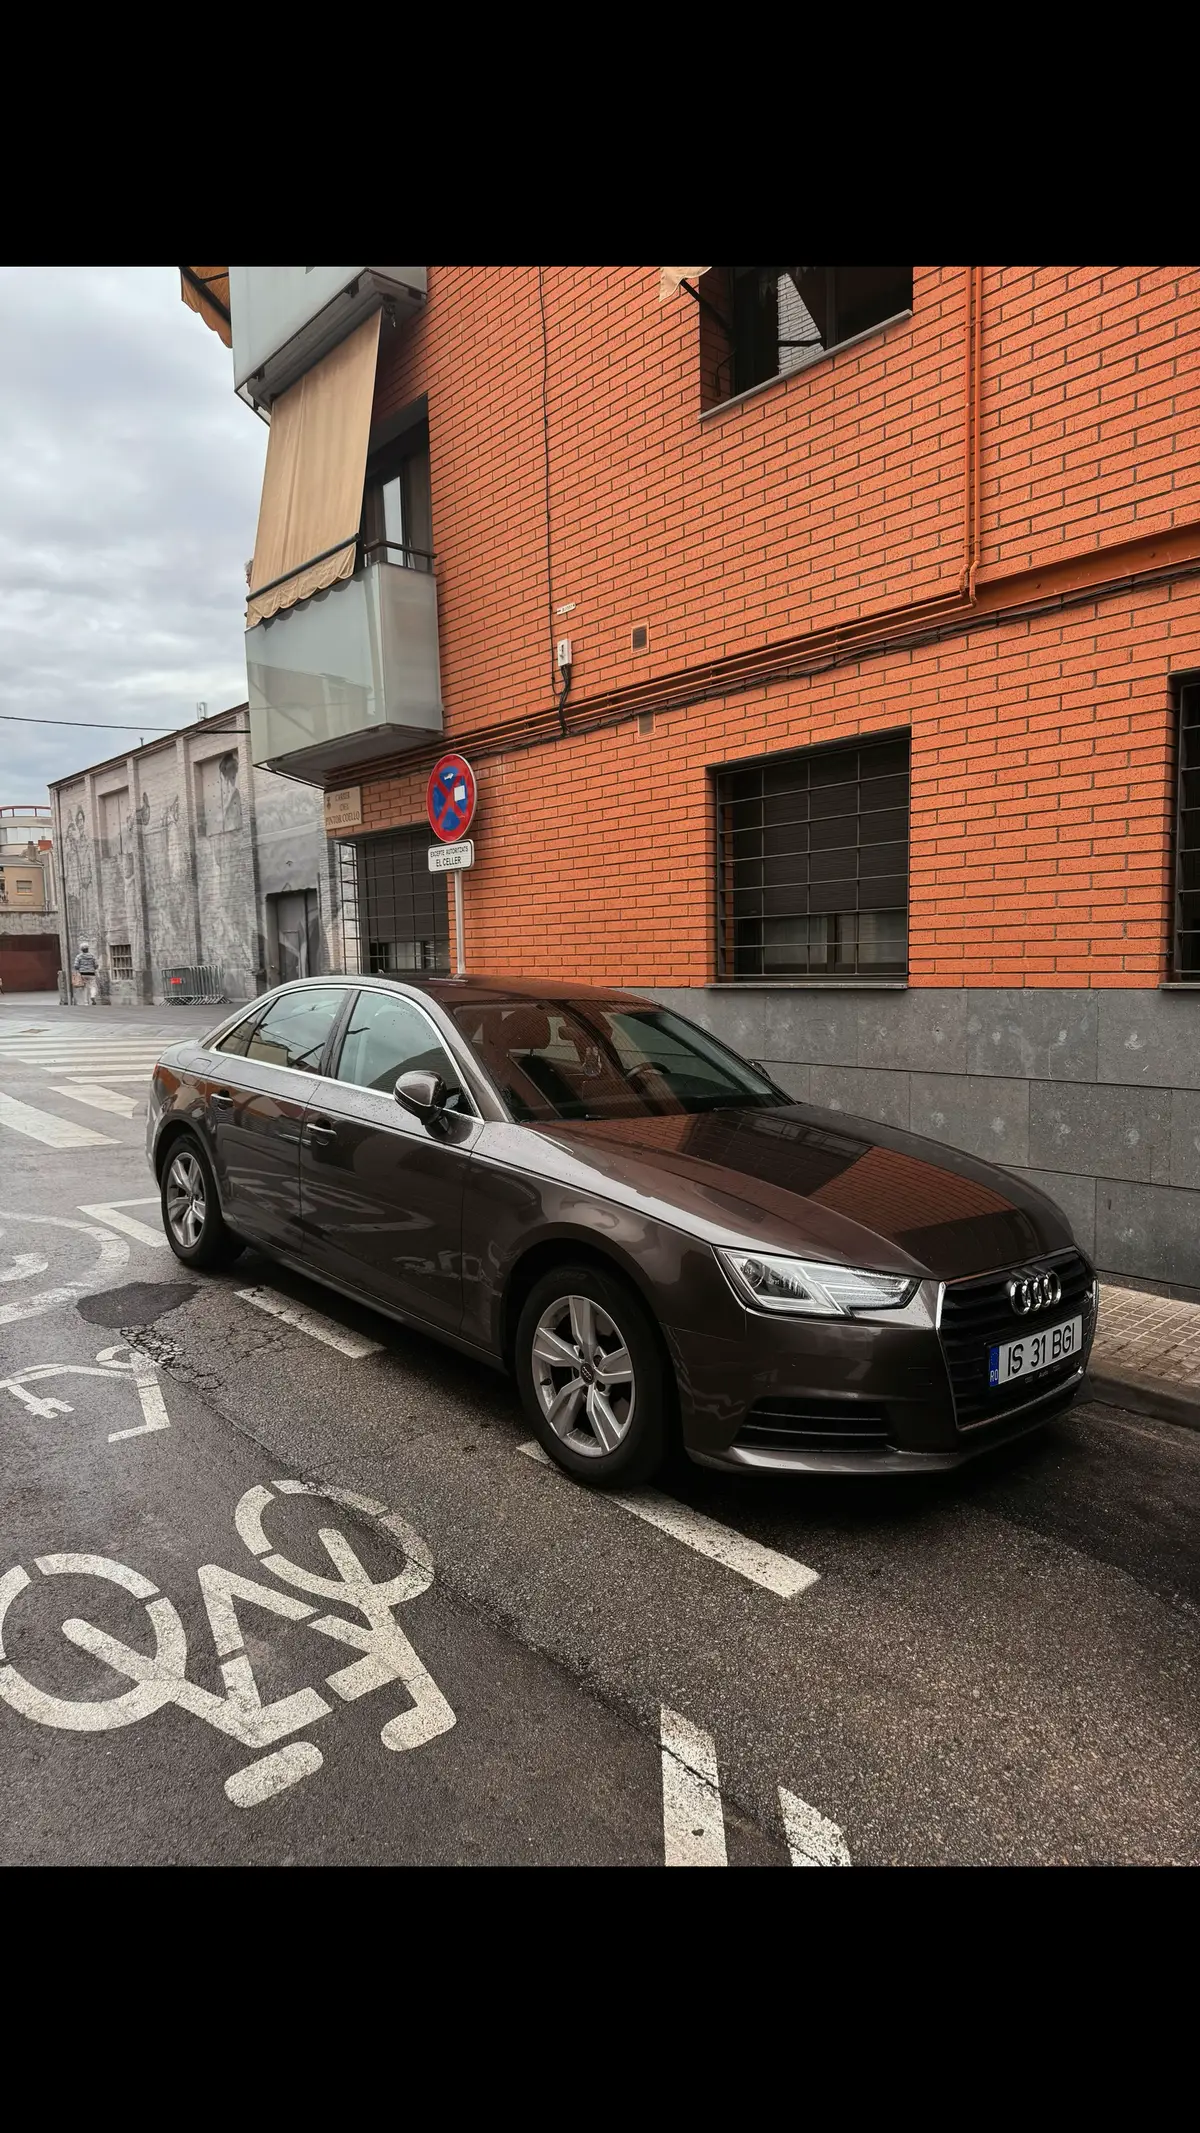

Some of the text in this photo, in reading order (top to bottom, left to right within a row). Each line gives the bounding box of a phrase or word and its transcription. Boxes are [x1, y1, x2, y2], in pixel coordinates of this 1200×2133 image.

[325, 815, 342, 826] PINTOR
[430, 849, 445, 857] EXCEPTE
[436, 856, 462, 867] EL CELLER
[1007, 1322, 1075, 1377] IS 31 BGI
[990, 1368, 998, 1382] RO
